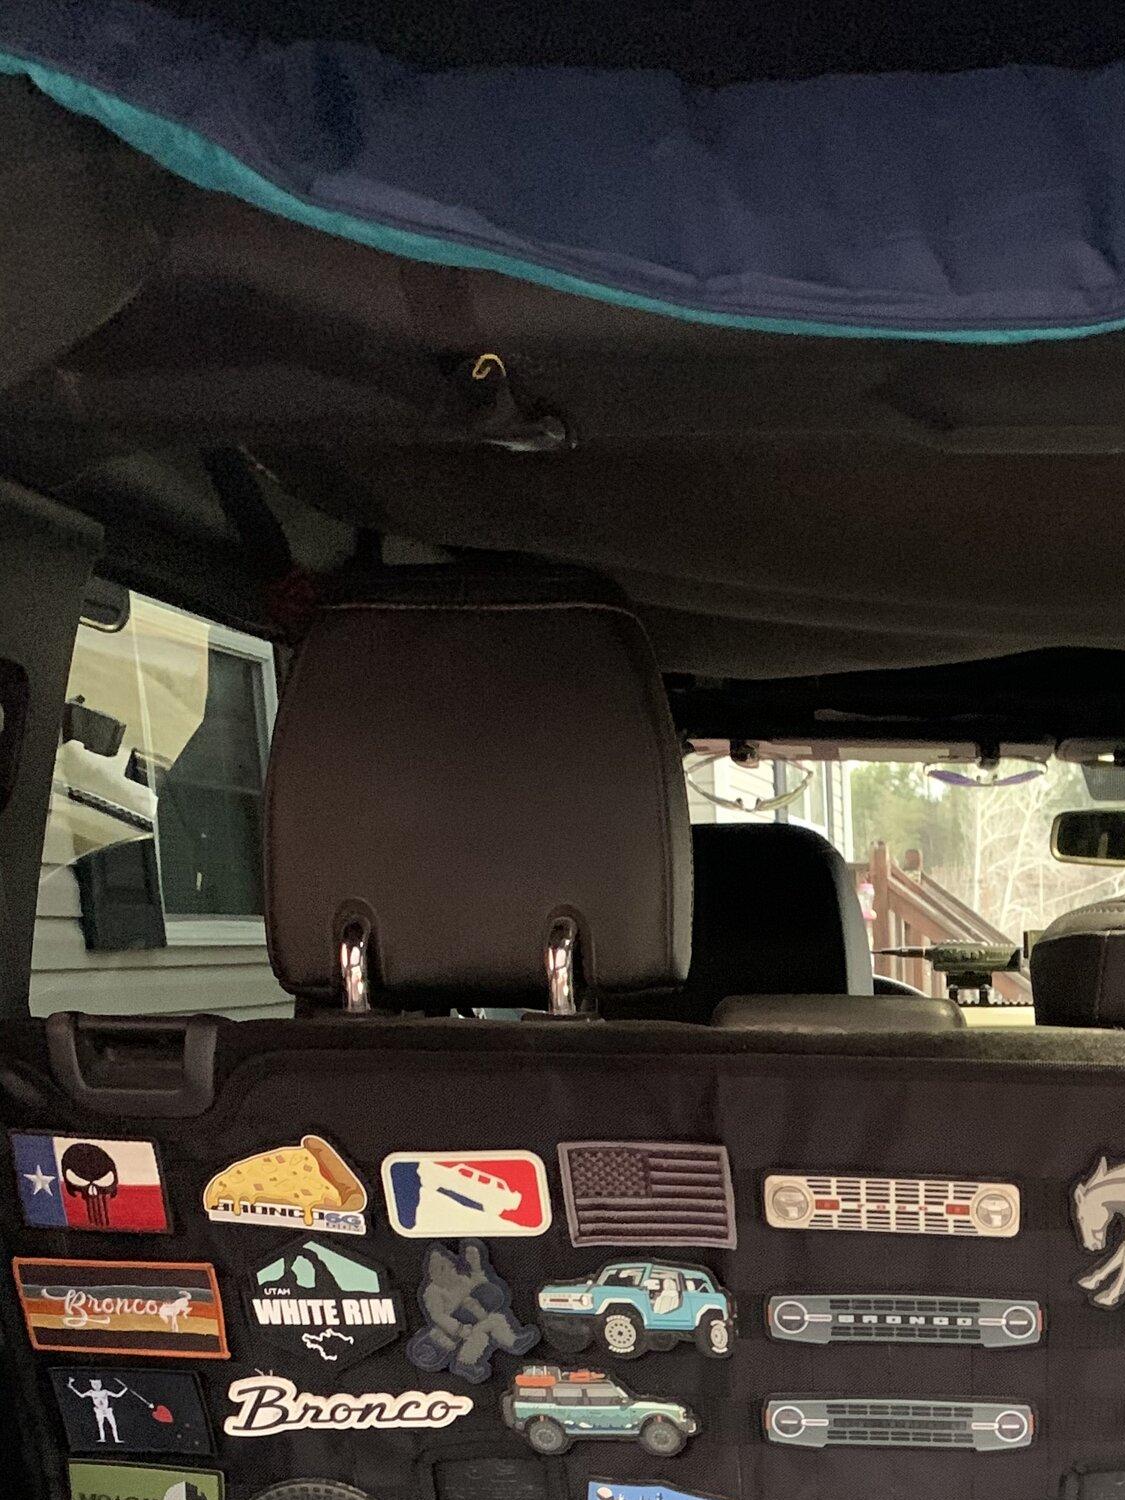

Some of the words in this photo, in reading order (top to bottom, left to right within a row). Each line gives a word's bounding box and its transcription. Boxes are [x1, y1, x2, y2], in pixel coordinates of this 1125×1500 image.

[41, 1289, 158, 1328] Bronco
[264, 1288, 291, 1296] UTAH
[252, 1299, 340, 1326] WHITE
[341, 1299, 397, 1325] RIM
[232, 1384, 464, 1431] Bronco
